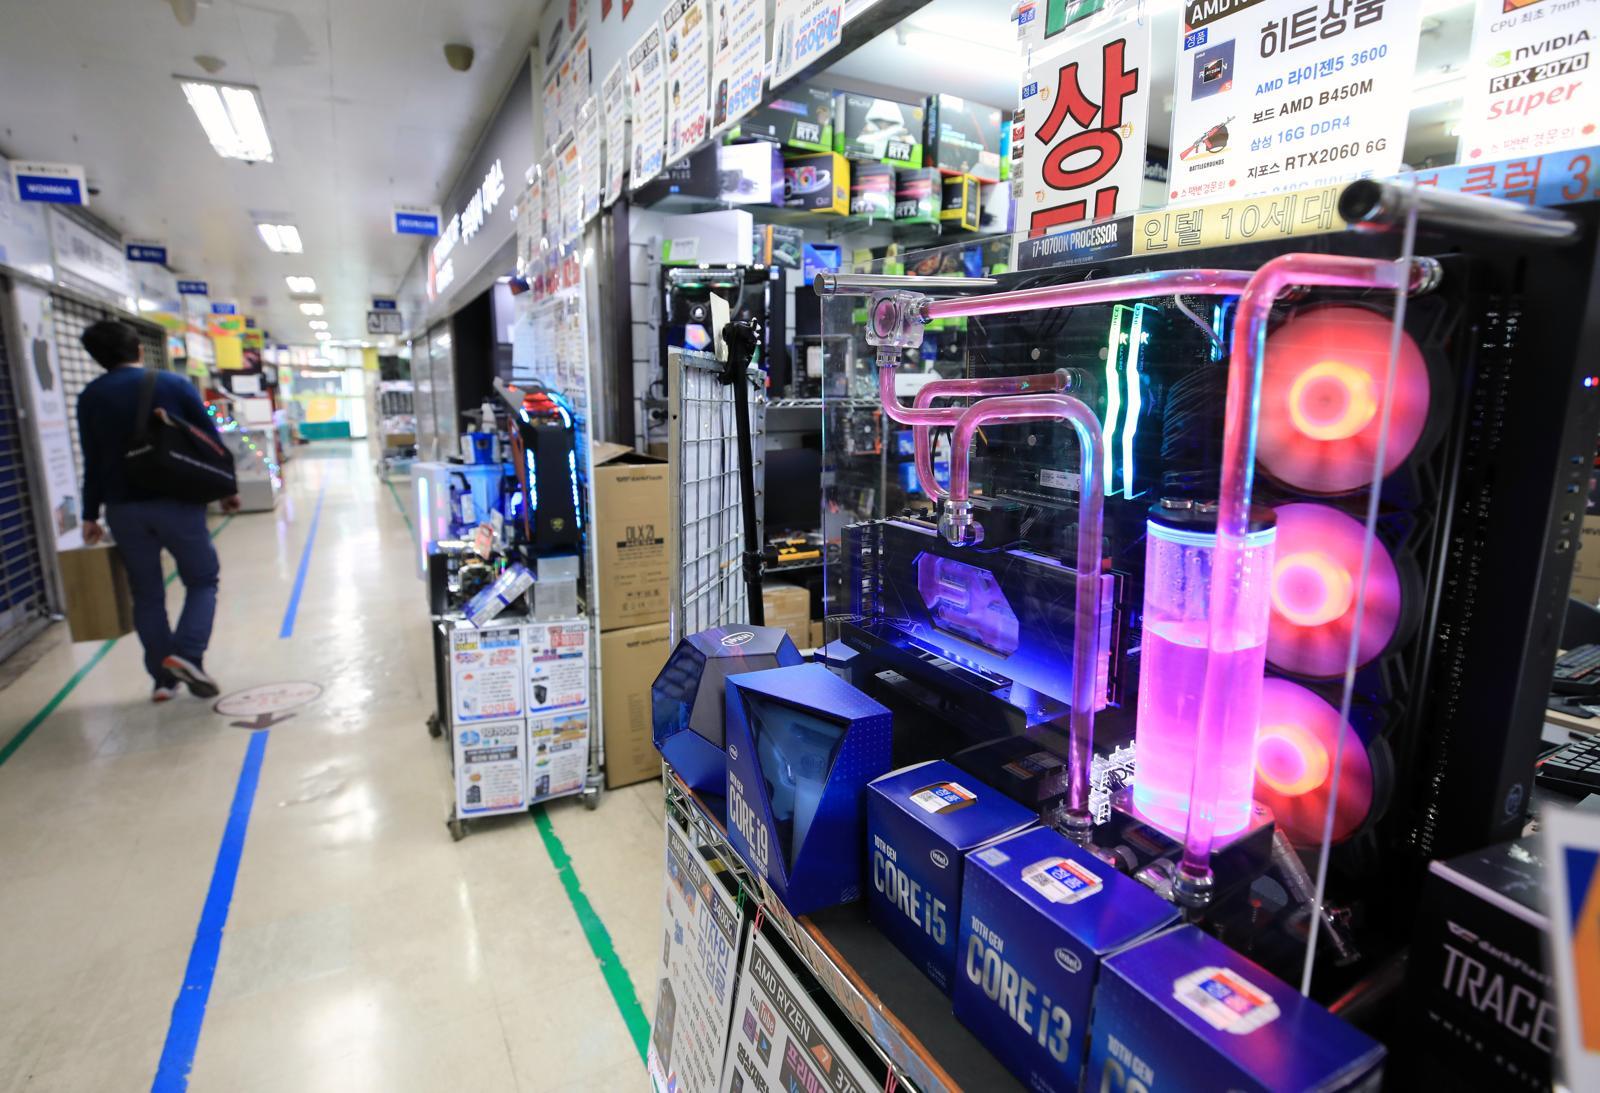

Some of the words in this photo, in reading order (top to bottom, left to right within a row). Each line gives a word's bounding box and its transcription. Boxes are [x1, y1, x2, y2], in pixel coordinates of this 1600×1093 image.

[1187, 30, 1206, 48] 정품
[1490, 18, 1517, 33] CPU
[1255, 78, 1283, 96] AMD
[1287, 56, 1344, 86] 라이젠5
[1350, 44, 1388, 67] 3600
[1492, 69, 1532, 93] RTX
[1535, 54, 1588, 81] 2070
[1252, 107, 1275, 124] 보드
[1279, 96, 1313, 118] AMD
[1318, 79, 1374, 106] B450M
[1250, 134, 1273, 152] 삼성
[1277, 126, 1306, 144] 16G
[1310, 115, 1352, 137] DDR4
[1247, 161, 1281, 180] 지포스
[1284, 142, 1361, 172] RTX2060
[1365, 138, 1388, 155] 6G
[1032, 234, 1070, 258] i7-10700K
[1069, 223, 1118, 251] PROCESSOR
[1143, 207, 1204, 251] 인텔
[1220, 187, 1337, 240] 10세대
[729, 783, 756, 851] CORE
[756, 818, 769, 867] i9
[874, 850, 922, 928] CORE
[925, 891, 947, 946] i5
[971, 916, 989, 942] 10TH
[988, 929, 1004, 954] GEN
[754, 958, 777, 993] AMD
[776, 987, 811, 1042] RYZEN
[966, 933, 1037, 1036] CORE
[1038, 994, 1072, 1064] i3
